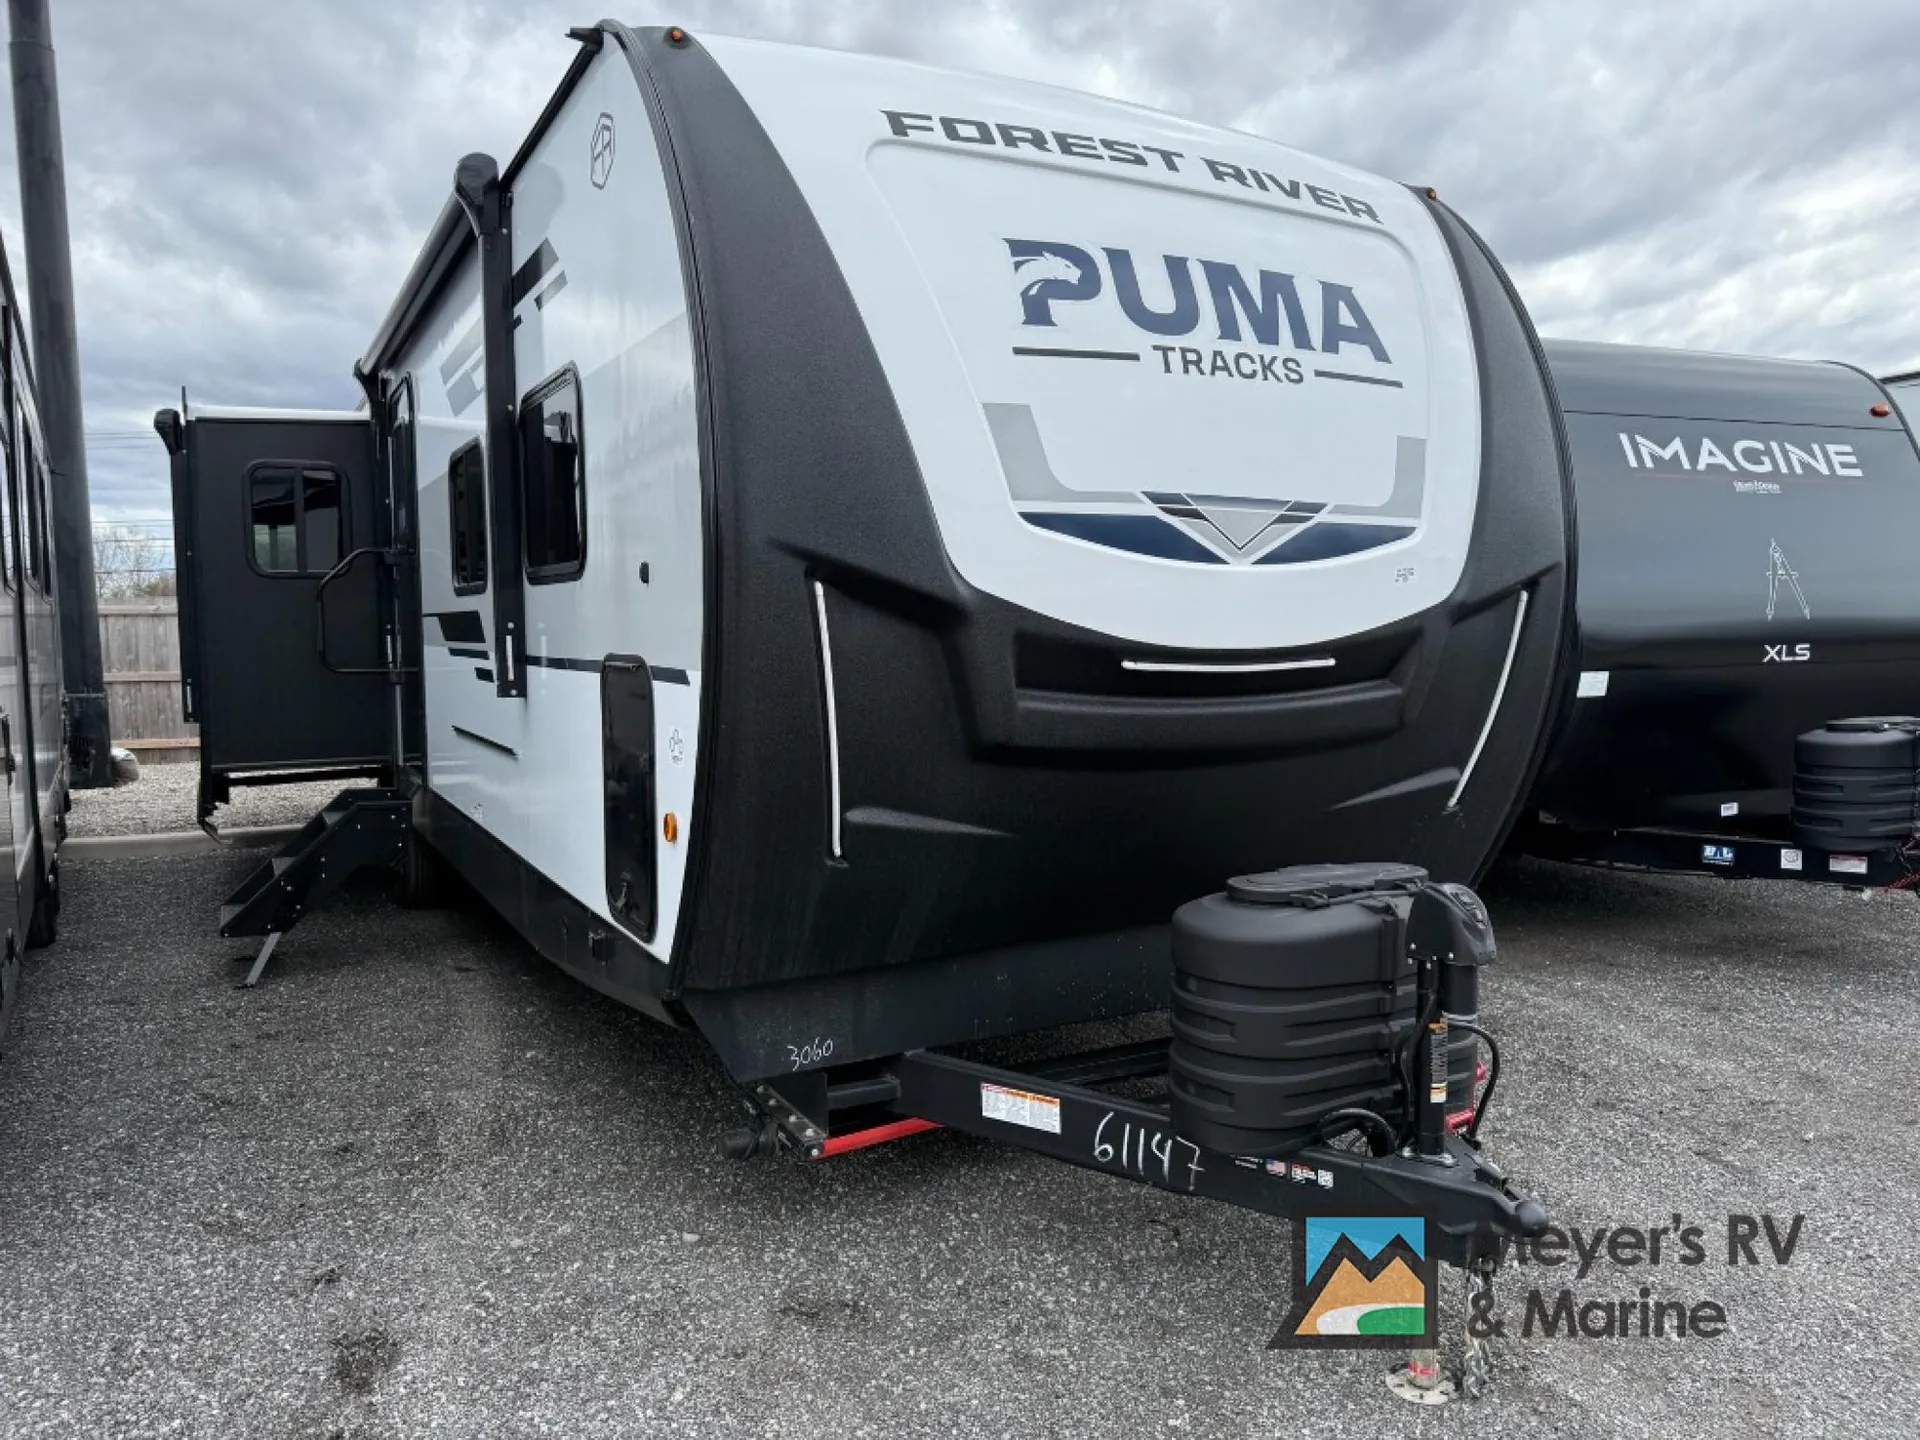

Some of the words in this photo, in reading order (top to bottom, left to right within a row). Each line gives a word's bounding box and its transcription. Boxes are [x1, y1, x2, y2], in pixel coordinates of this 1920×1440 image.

[879, 109, 1185, 173] FOREST
[1200, 157, 1384, 225] RIVER
[1001, 237, 1393, 365] PUMA
[1152, 344, 1304, 385] TRACKS
[1617, 432, 1864, 478] IMAGINE
[1762, 643, 1811, 663] XLS
[786, 1036, 834, 1071] 3060
[1093, 1111, 1206, 1192] 61147
